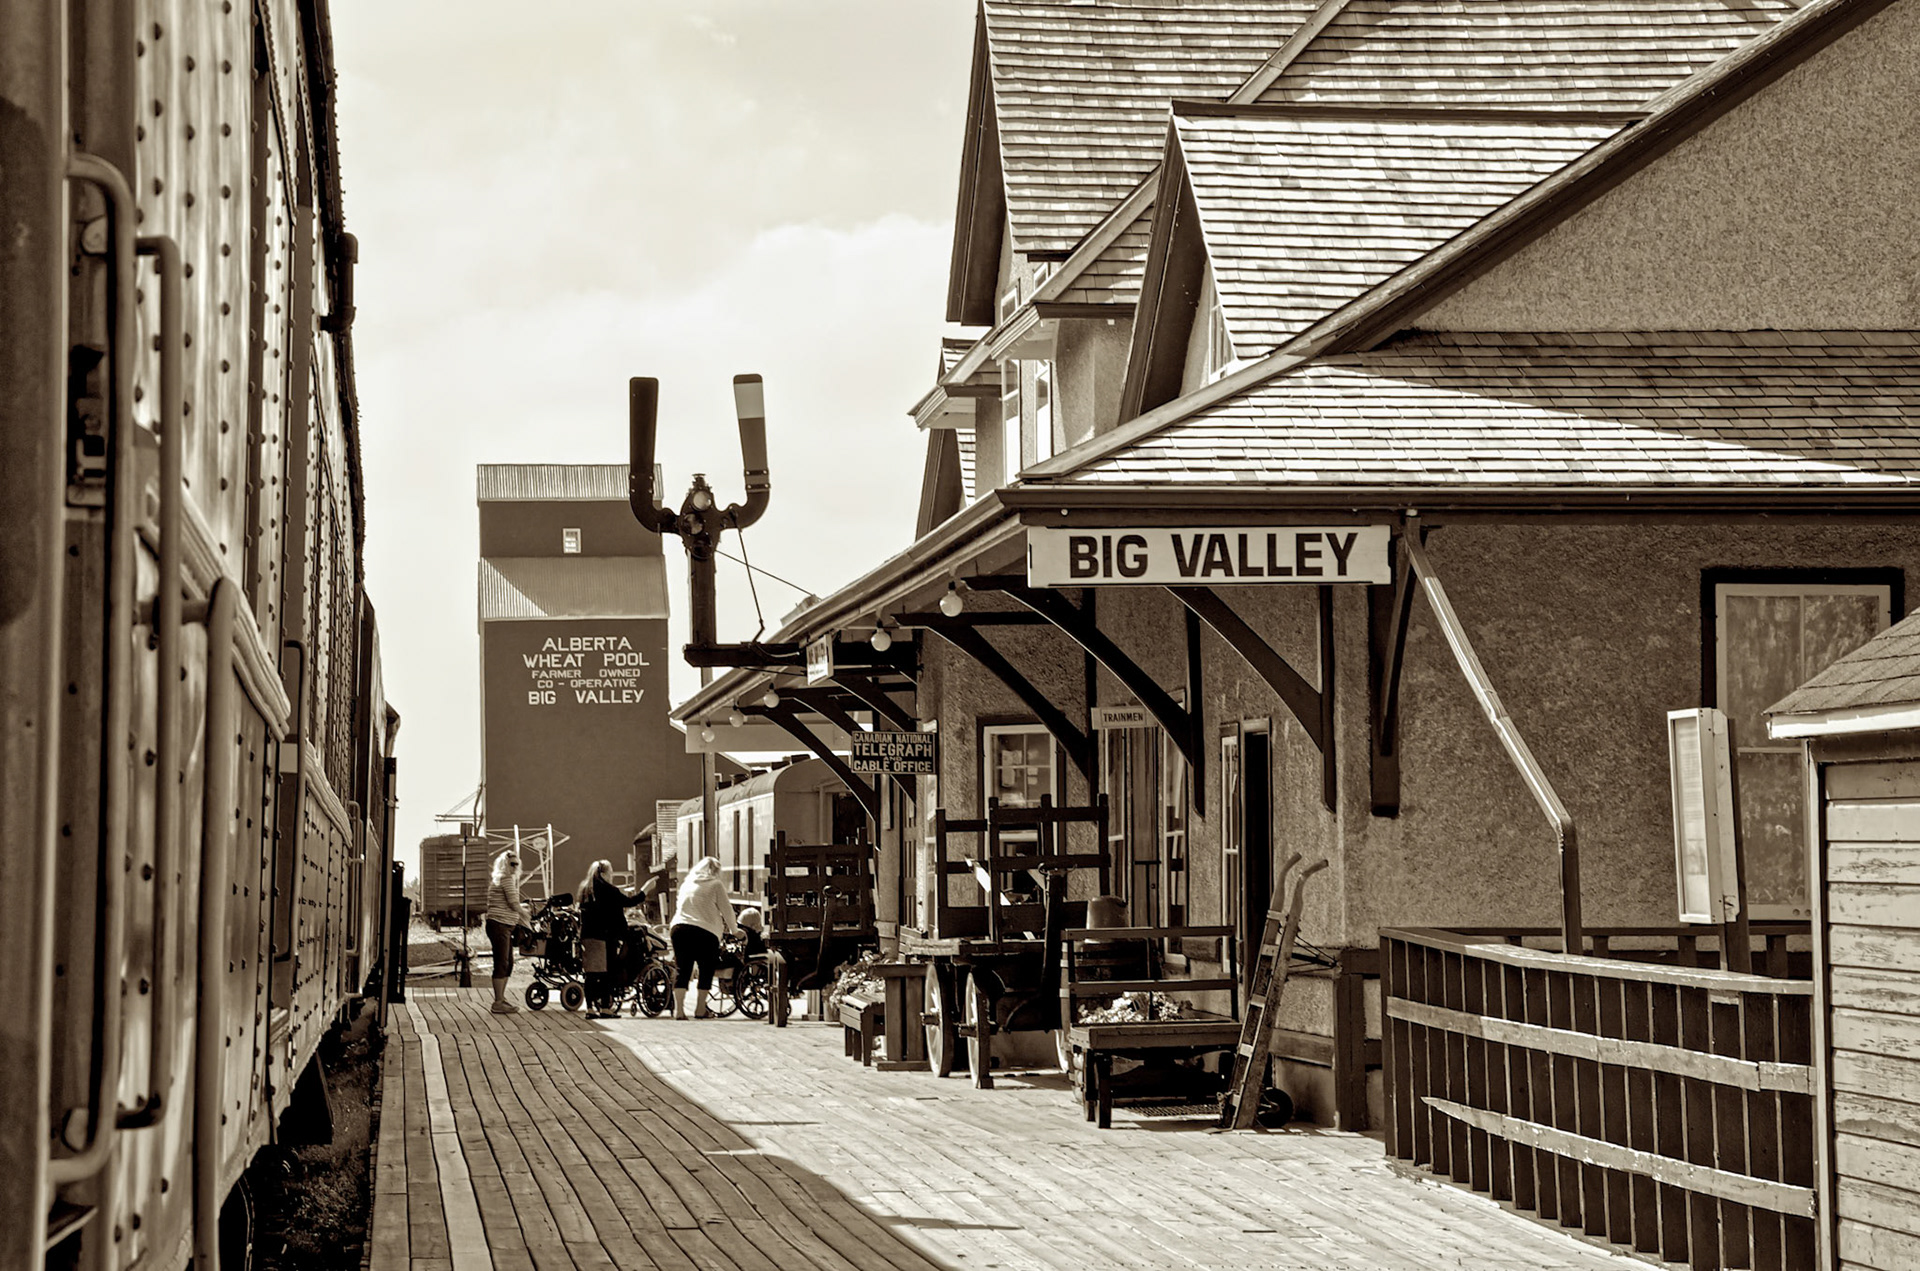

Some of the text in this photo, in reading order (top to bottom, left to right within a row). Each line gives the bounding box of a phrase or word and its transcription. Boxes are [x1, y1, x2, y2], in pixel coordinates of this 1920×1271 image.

[1069, 532, 1359, 578] BIG VALLEY
[542, 637, 632, 651] ALBERTA
[523, 653, 650, 668] WHEAT POOL
[532, 669, 641, 679] FARMER OWNED
[528, 690, 644, 705] BIG VALLEY
[1103, 713, 1144, 722] TRAINMEN
[854, 733, 932, 744] CANADIAN NATIONAL
[854, 743, 932, 757] TELEGRAPH
[854, 760, 932, 772] CABLE OFFICE
